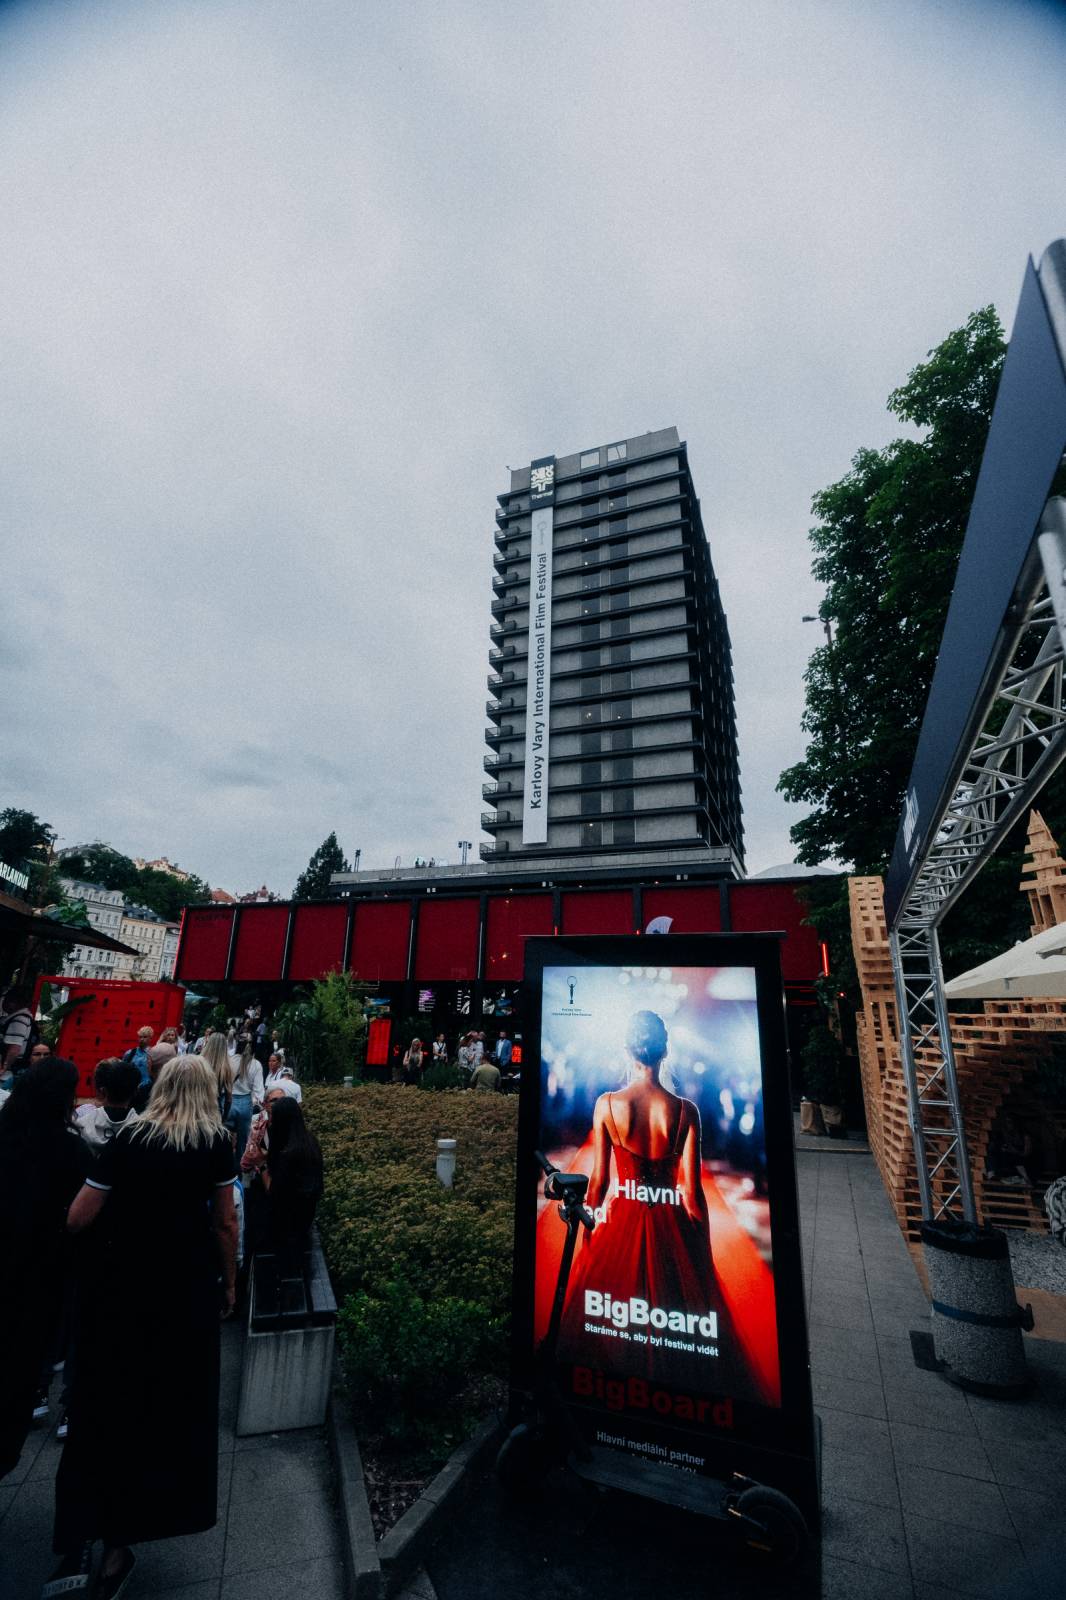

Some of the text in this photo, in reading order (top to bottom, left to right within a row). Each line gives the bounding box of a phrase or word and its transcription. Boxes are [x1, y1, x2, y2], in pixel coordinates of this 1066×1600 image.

[530, 552, 547, 809] Karlovy Vary International Film Festival
[585, 1289, 718, 1338] BigBoard
[584, 1322, 719, 1357] Staráme se, aby byl festival vidět
[574, 1365, 736, 1430] BigBoard
[596, 1430, 626, 1447] Hlavní
[627, 1438, 668, 1457] mediální
[669, 1448, 706, 1466] partner
